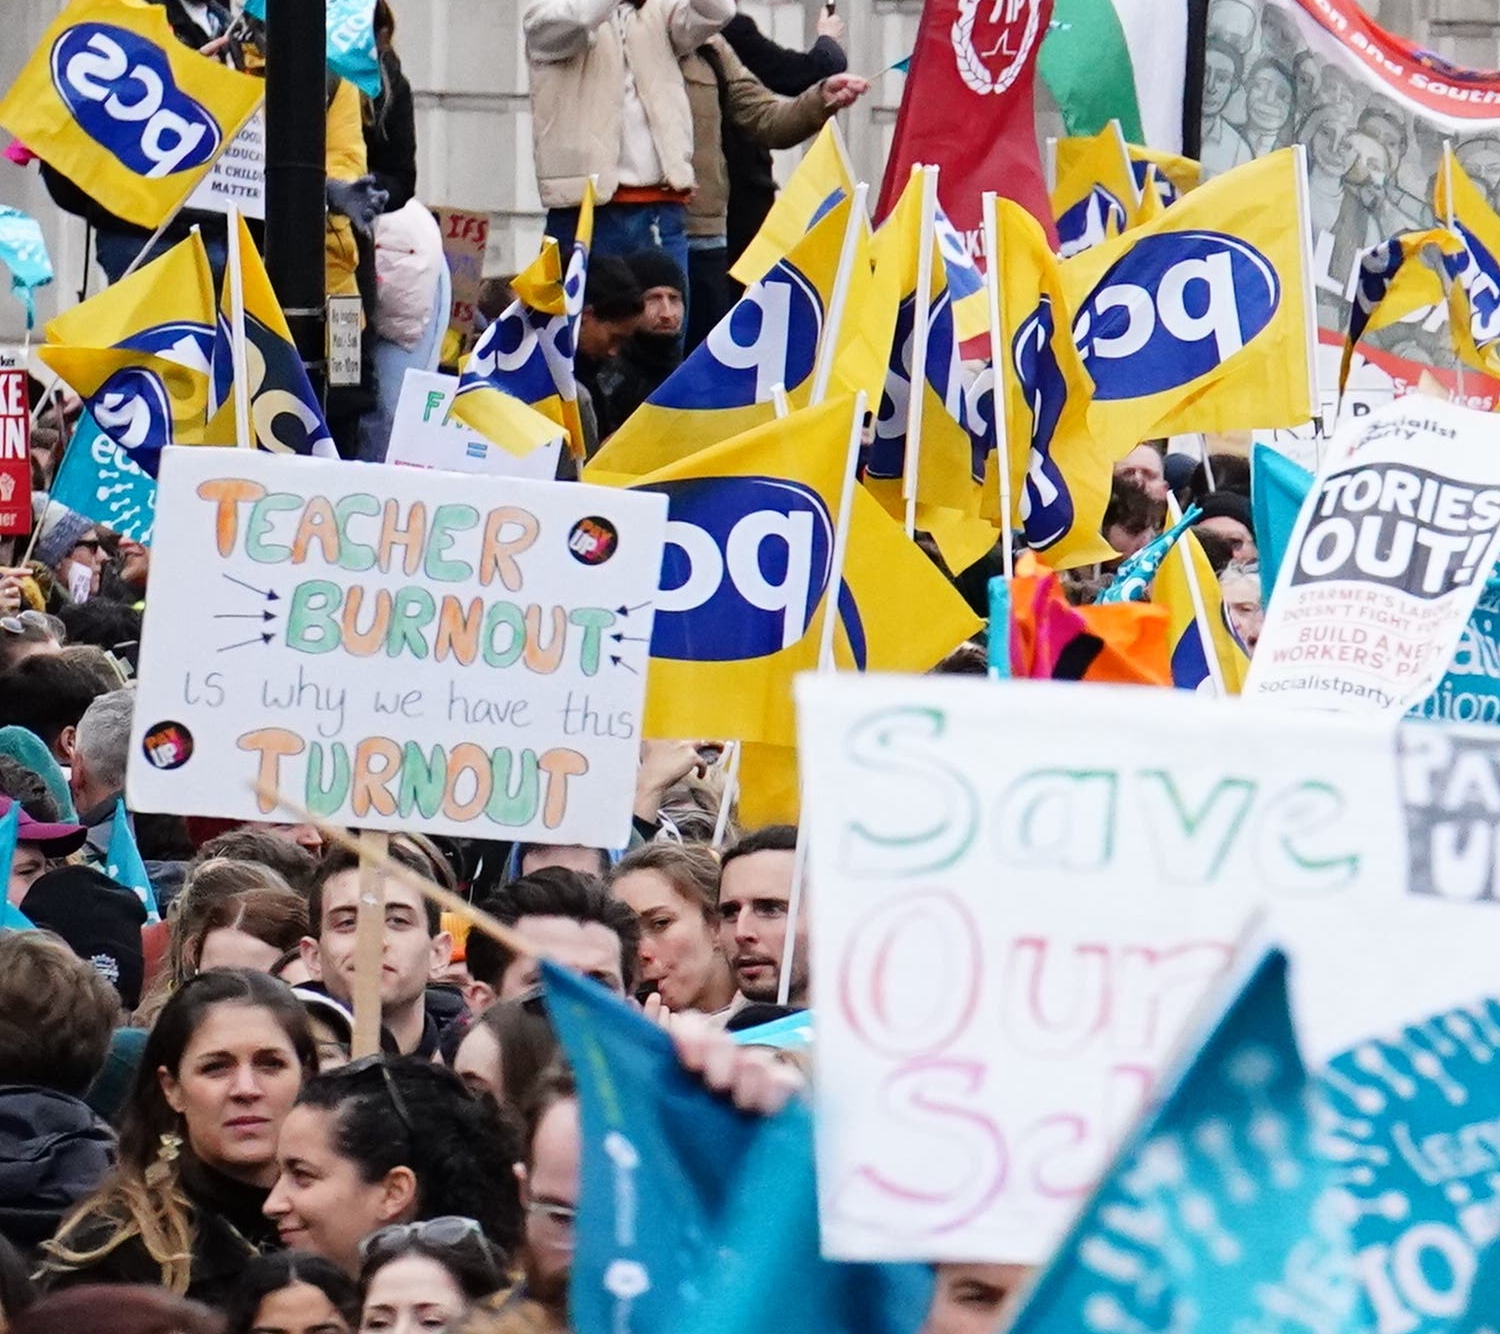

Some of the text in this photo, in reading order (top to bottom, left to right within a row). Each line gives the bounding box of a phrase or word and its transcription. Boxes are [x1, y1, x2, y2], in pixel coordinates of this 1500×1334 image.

[1348, 27, 1405, 78] and
[198, 477, 540, 592] TEACHER
[1299, 515, 1492, 594] OUT!
[286, 578, 617, 677] BURNOUT
[1300, 625, 1389, 653] BUILD A
[262, 665, 346, 737] why
[375, 690, 425, 718] we
[448, 679, 529, 728] have
[557, 689, 635, 739] this
[237, 727, 590, 829] TURNOUT
[844, 703, 1360, 880] Save
